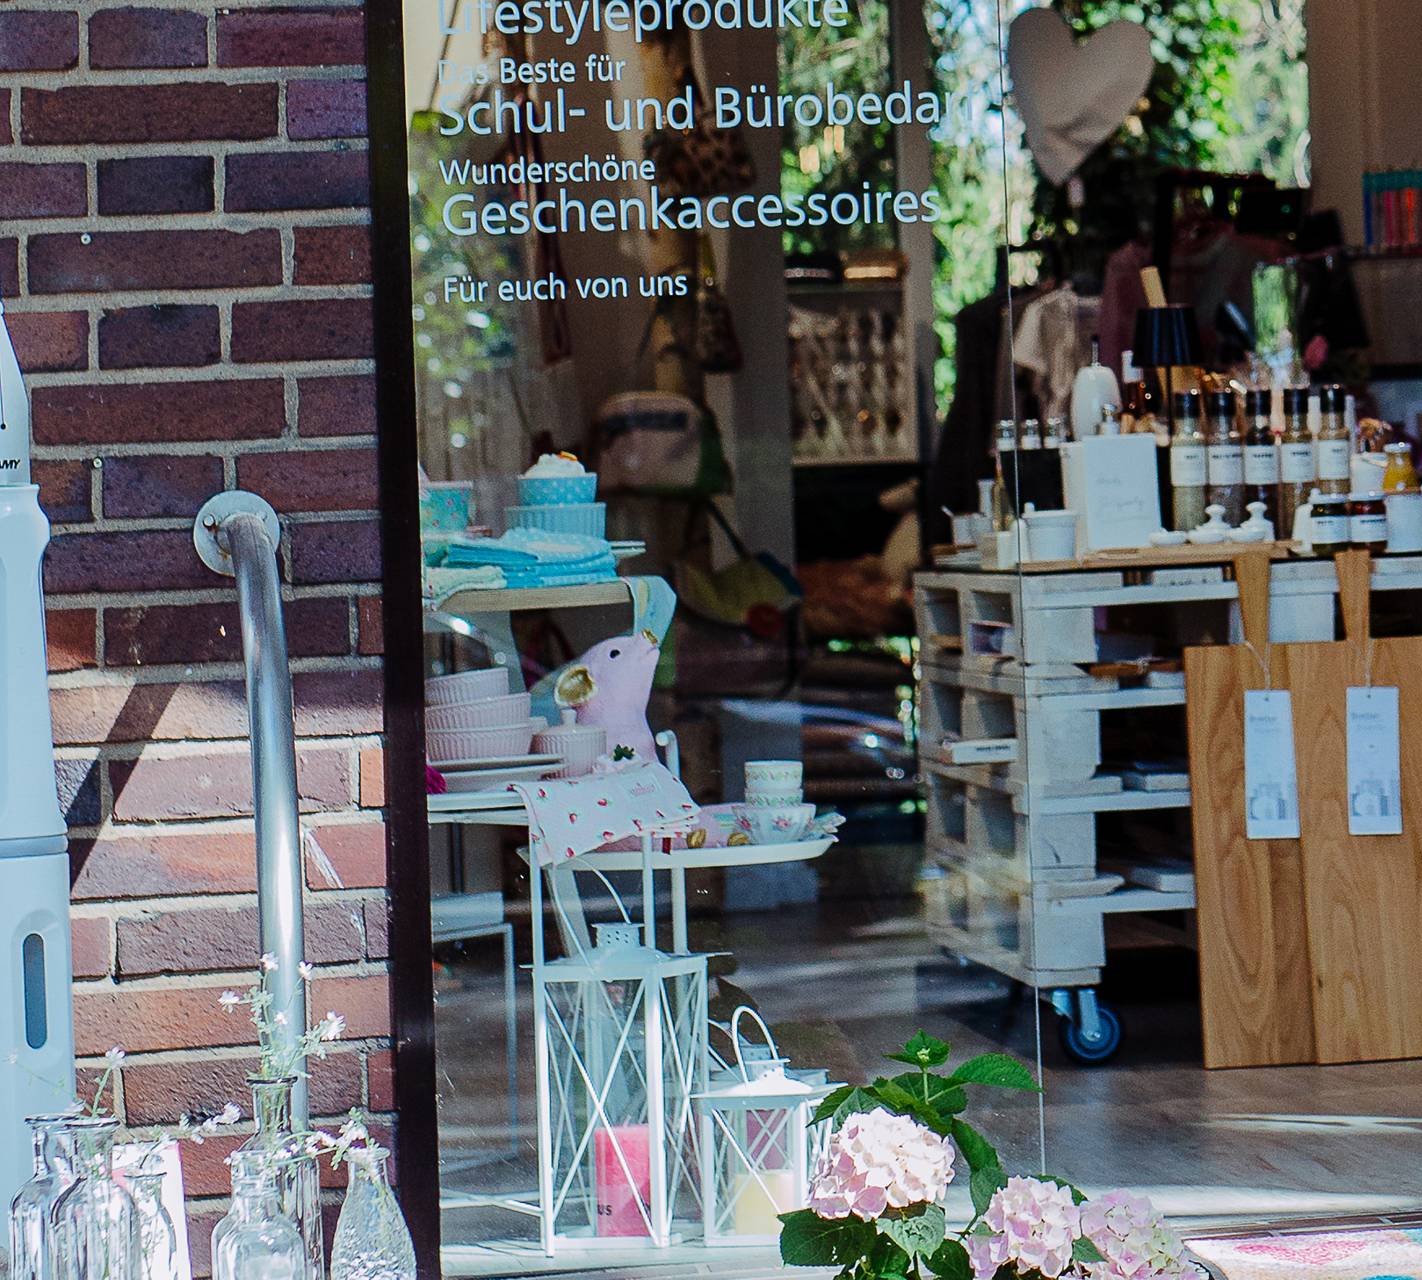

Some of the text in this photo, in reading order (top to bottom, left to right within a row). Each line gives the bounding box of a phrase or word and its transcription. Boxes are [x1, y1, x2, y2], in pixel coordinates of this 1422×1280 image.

[438, 0, 849, 45] Lifestyleprodukte
[438, 53, 627, 85] Das Beste für
[439, 87, 586, 136] Schul-
[605, 85, 694, 132] und
[438, 154, 655, 185] Wunderschöne
[442, 182, 942, 236] Geschenkaccessoires
[443, 272, 688, 303] Für euch von uns
